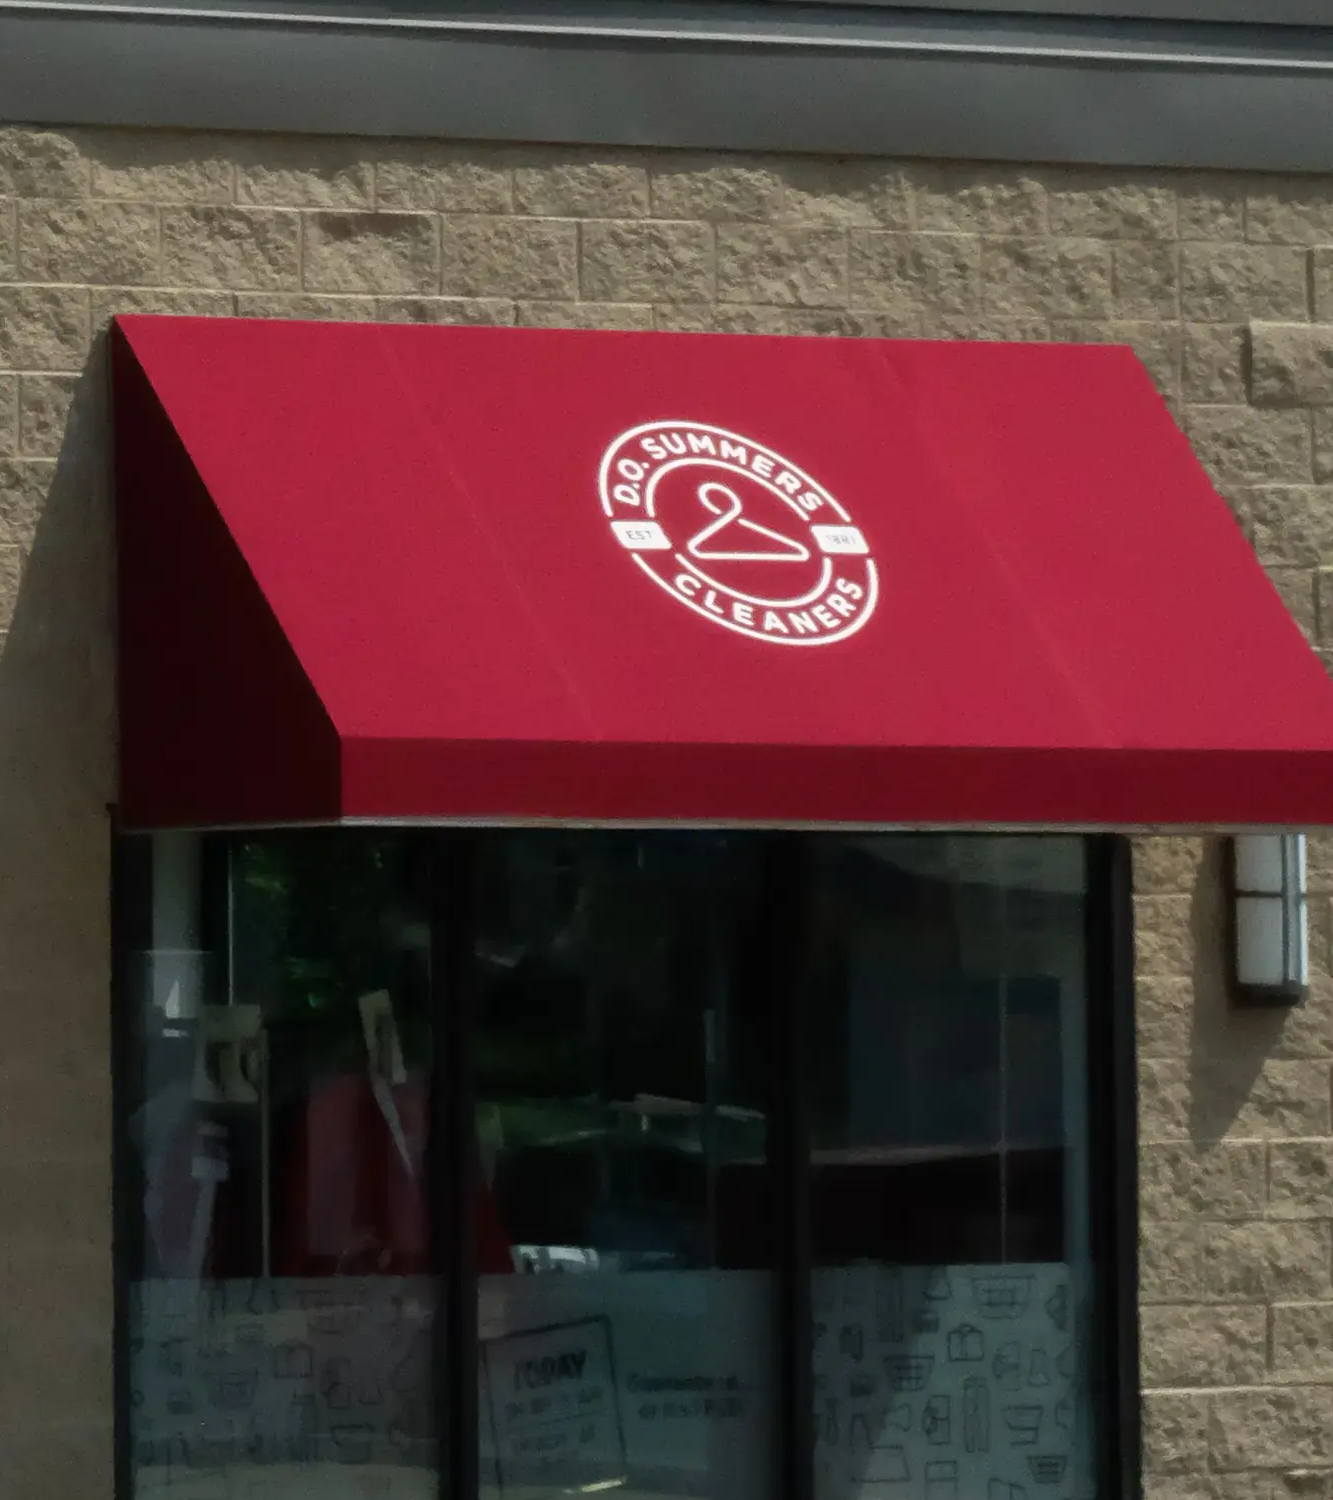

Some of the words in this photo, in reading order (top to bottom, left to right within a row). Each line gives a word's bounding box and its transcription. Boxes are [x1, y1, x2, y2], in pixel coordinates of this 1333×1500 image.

[613, 458, 651, 507] D.O.
[640, 432, 825, 512] SUMMERS
[674, 573, 864, 635] CLEANERS
